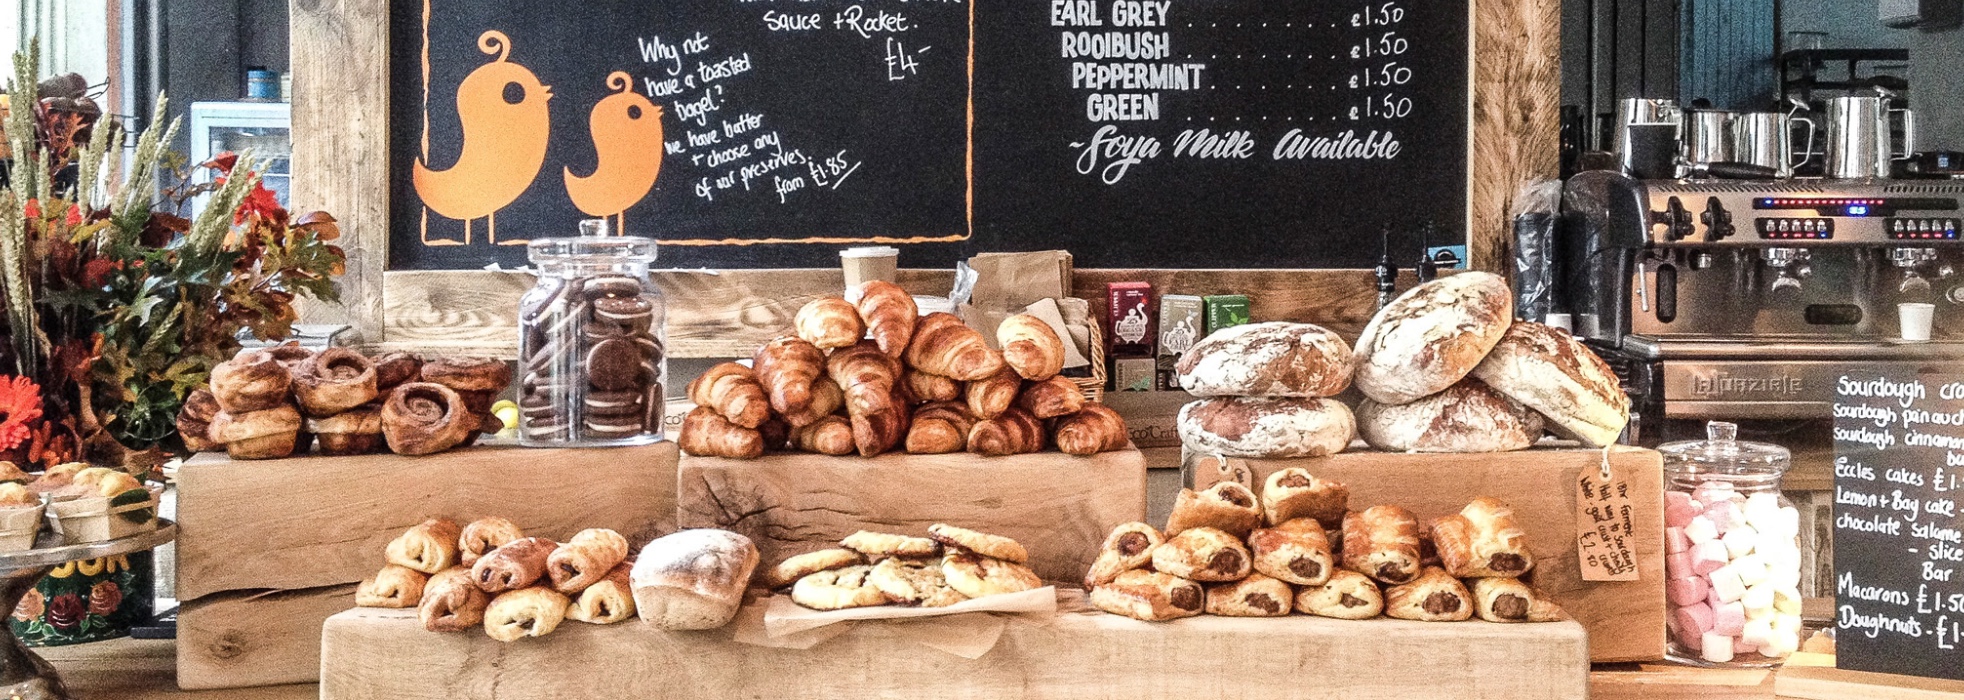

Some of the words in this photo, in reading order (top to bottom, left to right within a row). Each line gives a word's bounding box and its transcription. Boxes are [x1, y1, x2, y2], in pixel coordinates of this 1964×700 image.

[763, 10, 821, 31] Sauce
[1051, 0, 1102, 26] EARL
[1112, 0, 1171, 26] GREY
[638, 35, 682, 76] Why
[682, 31, 709, 54] not
[1062, 31, 1170, 60] ROOIBUSH
[644, 76, 683, 97] have
[684, 74, 696, 89] a
[697, 52, 751, 82] toasted
[1072, 62, 1206, 91] PEPPERMINT
[674, 84, 724, 126] bagel?
[1086, 93, 1160, 121] GREEN
[664, 140, 686, 155] we
[687, 130, 721, 147] have
[707, 144, 751, 167] choose
[754, 130, 782, 157] any
[1173, 129, 1255, 159] Milk
[695, 177, 713, 201] of
[774, 175, 805, 204] from
[1837, 375, 1926, 408] Sourdough
[1885, 468, 1924, 486] cakes
[1836, 485, 1877, 507] Lemon
[1891, 489, 1919, 522] Bay
[1924, 498, 1955, 517] cake
[1836, 512, 1901, 536] chocolate
[1922, 561, 1953, 582] Bar
[1838, 571, 1910, 606] Macarons
[1838, 604, 1922, 638] Doughnuts
